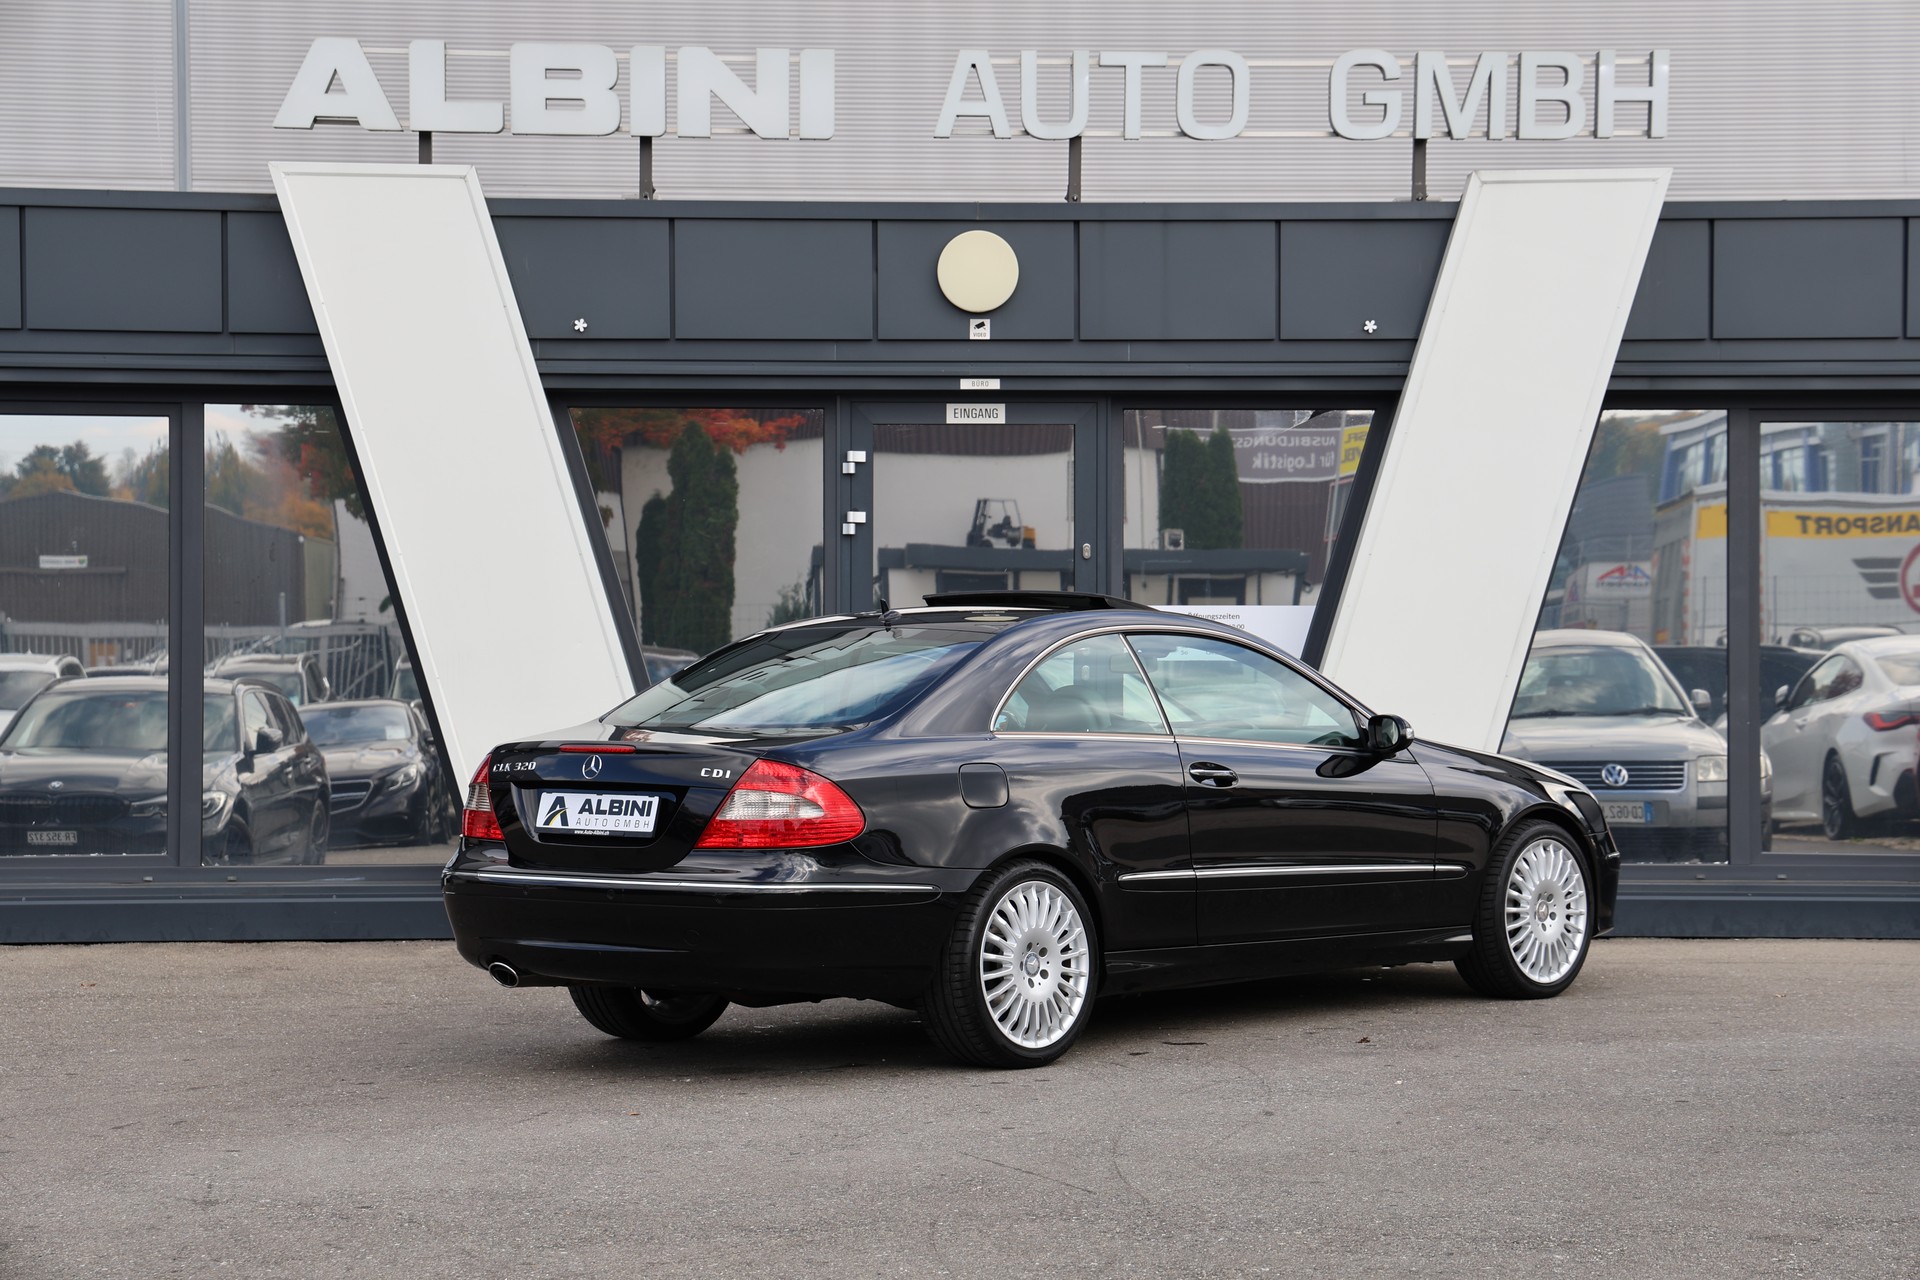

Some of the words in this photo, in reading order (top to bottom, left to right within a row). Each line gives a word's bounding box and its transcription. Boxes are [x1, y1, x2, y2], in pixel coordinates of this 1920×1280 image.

[272, 37, 835, 140] ALBINI
[933, 48, 1250, 140] AUTO
[1328, 48, 1670, 141] GMBH
[953, 407, 999, 419] EINGANG
[492, 762, 511, 772] CLK
[513, 761, 537, 771] 320
[700, 767, 731, 779] CDI
[577, 798, 653, 817] ALBINI
[576, 817, 608, 828] AUTO
[614, 818, 650, 829] GMBH
